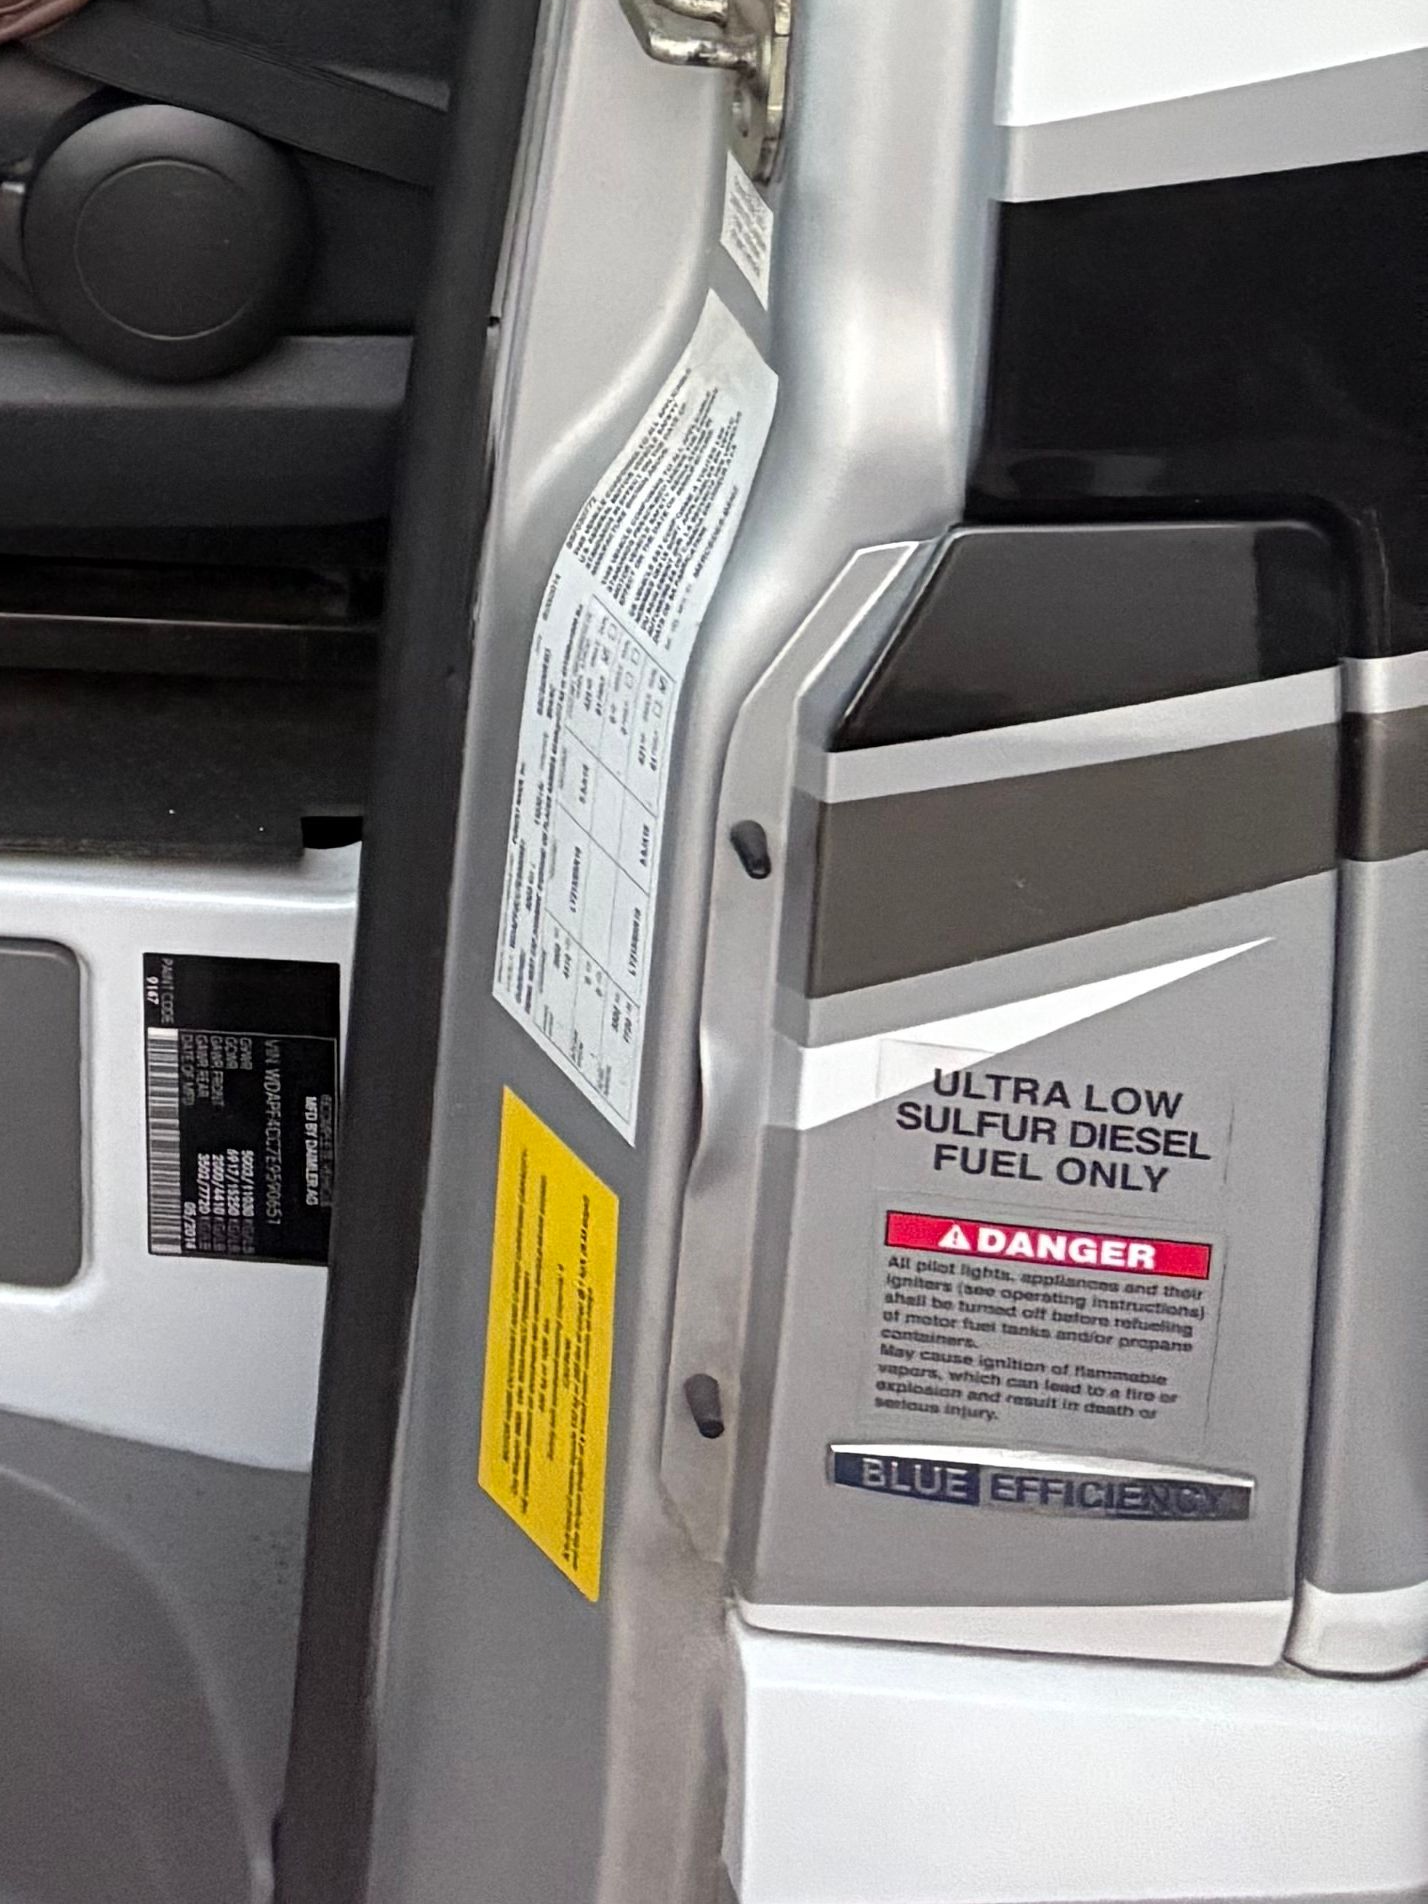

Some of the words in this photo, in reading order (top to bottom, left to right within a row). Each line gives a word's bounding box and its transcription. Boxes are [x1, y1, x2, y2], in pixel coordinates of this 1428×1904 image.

[161, 992, 174, 1024] CODE
[265, 1038, 280, 1064] VIN
[304, 1096, 317, 1121] MFD
[932, 1067, 1072, 1109] ULTRA
[1085, 1083, 1183, 1121] LOW
[305, 1122, 317, 1137] BY
[895, 1100, 1057, 1145] SULFUR
[1069, 1118, 1213, 1162] DIESEL
[304, 1139, 319, 1188] DAIMLER
[932, 1142, 1044, 1181] FUEL
[1055, 1154, 1169, 1195] ONLY
[305, 1189, 318, 1205] AG
[976, 1226, 1156, 1272] DANGER
[885, 1272, 952, 1293] igniters
[958, 1280, 996, 1299] (see
[1000, 1284, 1086, 1309] operating
[1091, 1294, 1205, 1321] instructions)
[887, 1255, 910, 1270] All
[916, 1258, 955, 1277] pilot
[1020, 1269, 1119, 1296] appliances
[1123, 1281, 1157, 1296] and
[1164, 1285, 1202, 1301] their
[882, 1308, 900, 1322] of
[905, 1311, 956, 1329] motor
[963, 1317, 995, 1333] fuel
[1002, 1321, 1051, 1339] tanks
[1055, 1327, 1113, 1346] and/or
[1117, 1334, 1193, 1357] propane
[884, 1290, 925, 1307] shall
[931, 1296, 952, 1310] be
[959, 1298, 1017, 1317] turned
[1021, 1305, 1048, 1320] off
[1052, 1308, 1108, 1327] before
[1114, 1315, 1193, 1338] refueling
[880, 1326, 978, 1349] containers.
[879, 1342, 915, 1361] May
[919, 1348, 972, 1365] cause
[977, 1353, 1045, 1376] ignition
[1050, 1362, 1069, 1375] of
[1074, 1364, 1167, 1386] flammable
[948, 1368, 1000, 1386] which
[1005, 1376, 1038, 1390] can
[1044, 1378, 1081, 1394] lead
[1086, 1383, 1105, 1396] to
[1109, 1388, 1120, 1398] a
[1125, 1387, 1155, 1402] fire
[1159, 1393, 1177, 1404] or
[874, 1394, 939, 1415] serious
[943, 1403, 998, 1423] injury.
[875, 1378, 962, 1402] explosion
[966, 1387, 1000, 1403] and
[1005, 1392, 1057, 1409] result
[1062, 1398, 1079, 1411] in
[1083, 1400, 1134, 1417] death
[1138, 1408, 1157, 1420] or
[861, 1456, 968, 1497] BLUE
[991, 1470, 1219, 1521] EFFICIENCY
